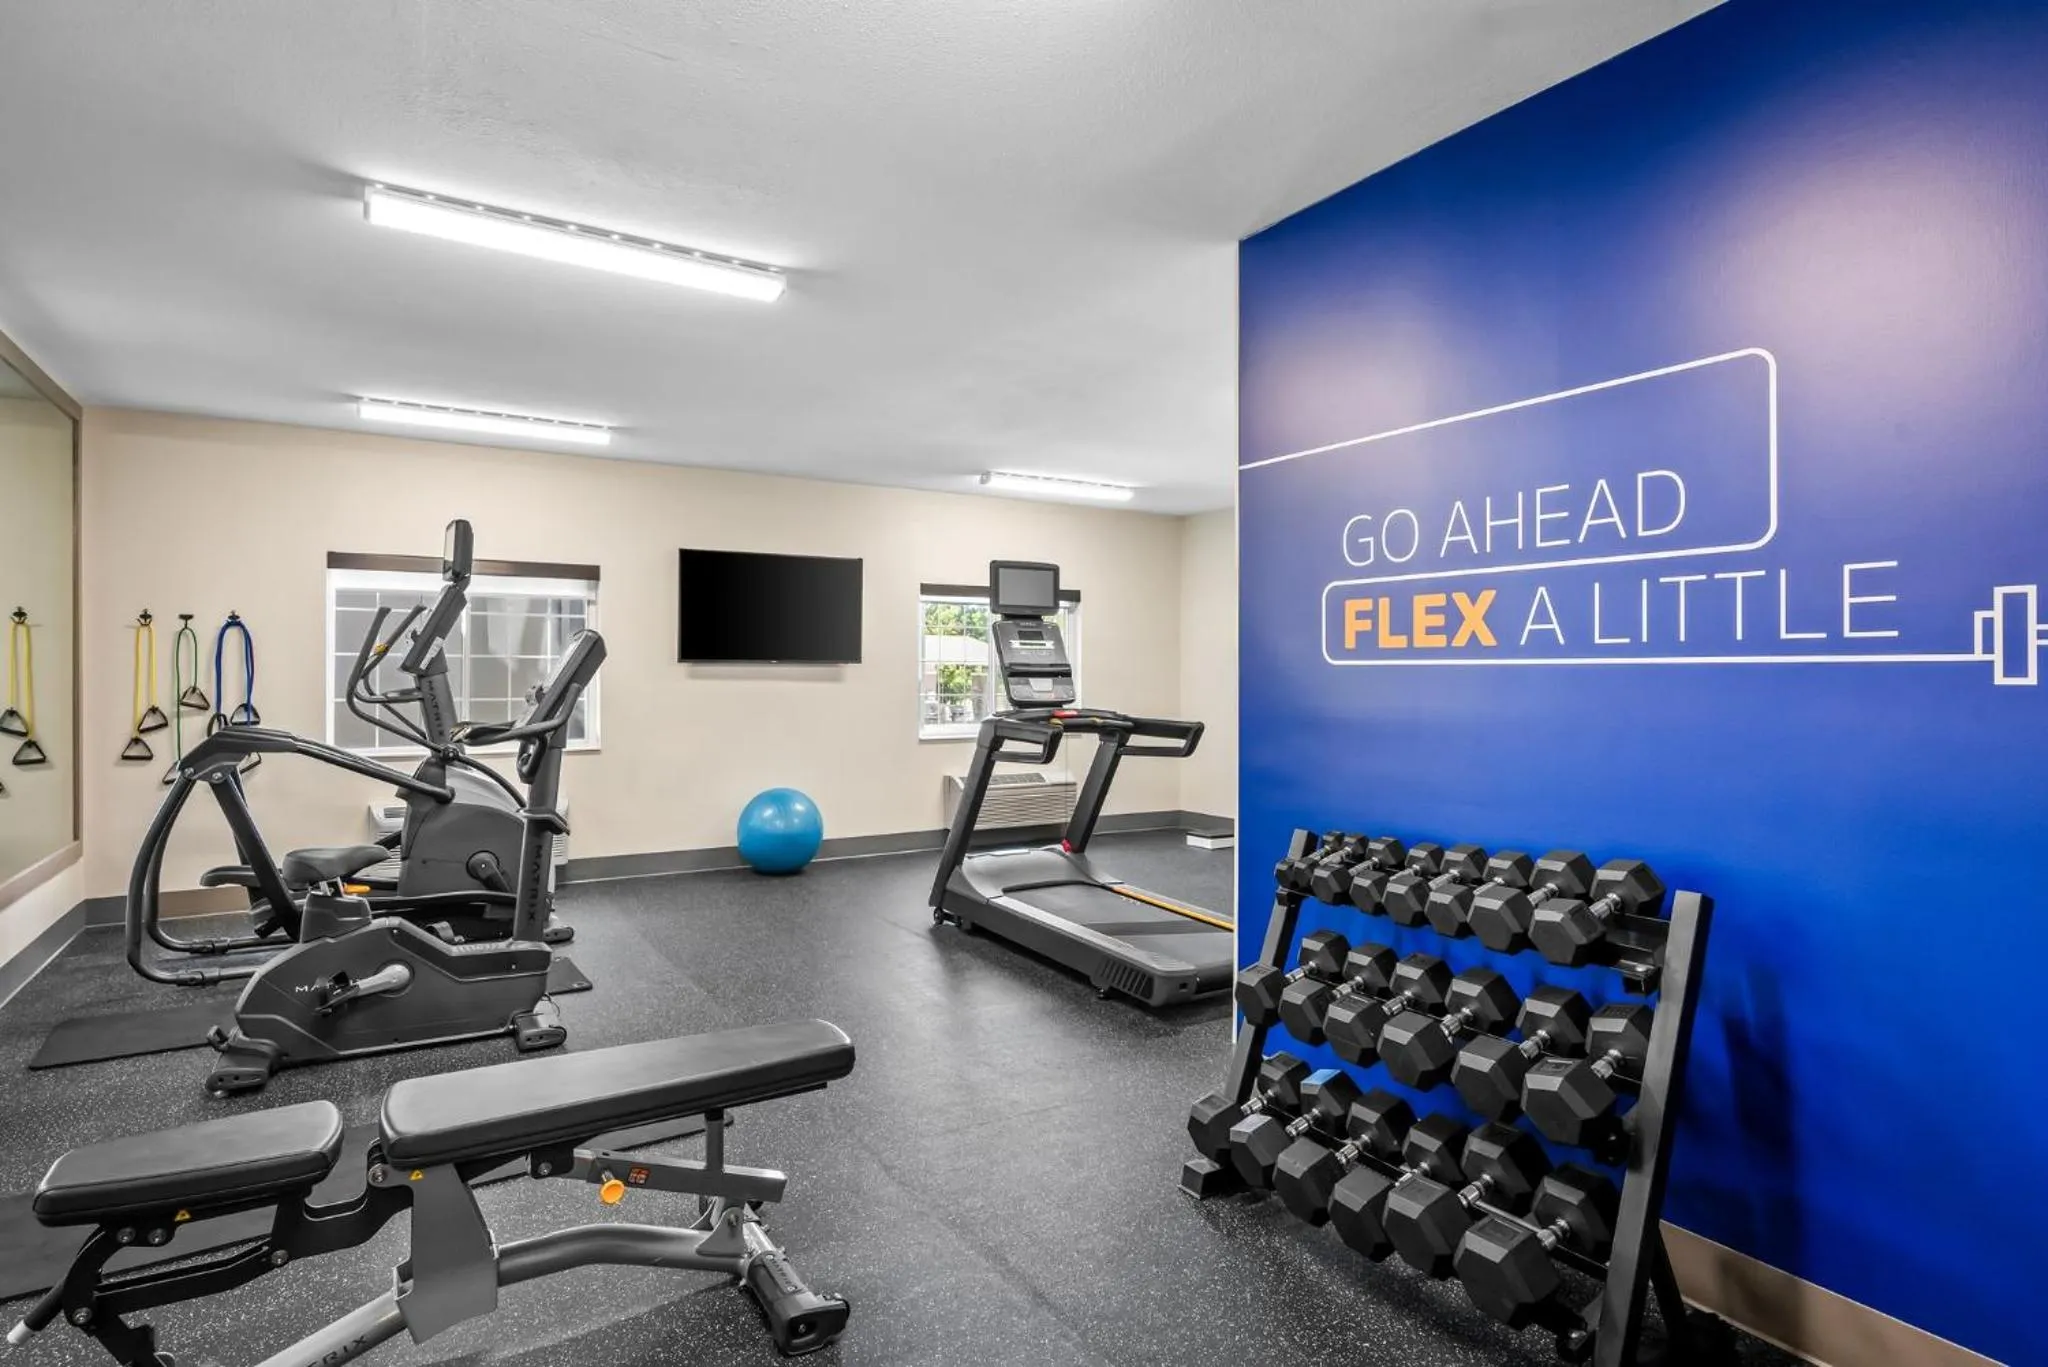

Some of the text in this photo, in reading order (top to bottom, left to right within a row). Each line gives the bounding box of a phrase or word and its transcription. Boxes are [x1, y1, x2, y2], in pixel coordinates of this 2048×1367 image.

[1342, 469, 1687, 567] GO AHEAD
[1343, 560, 1900, 650] FLEX A LITTLE
